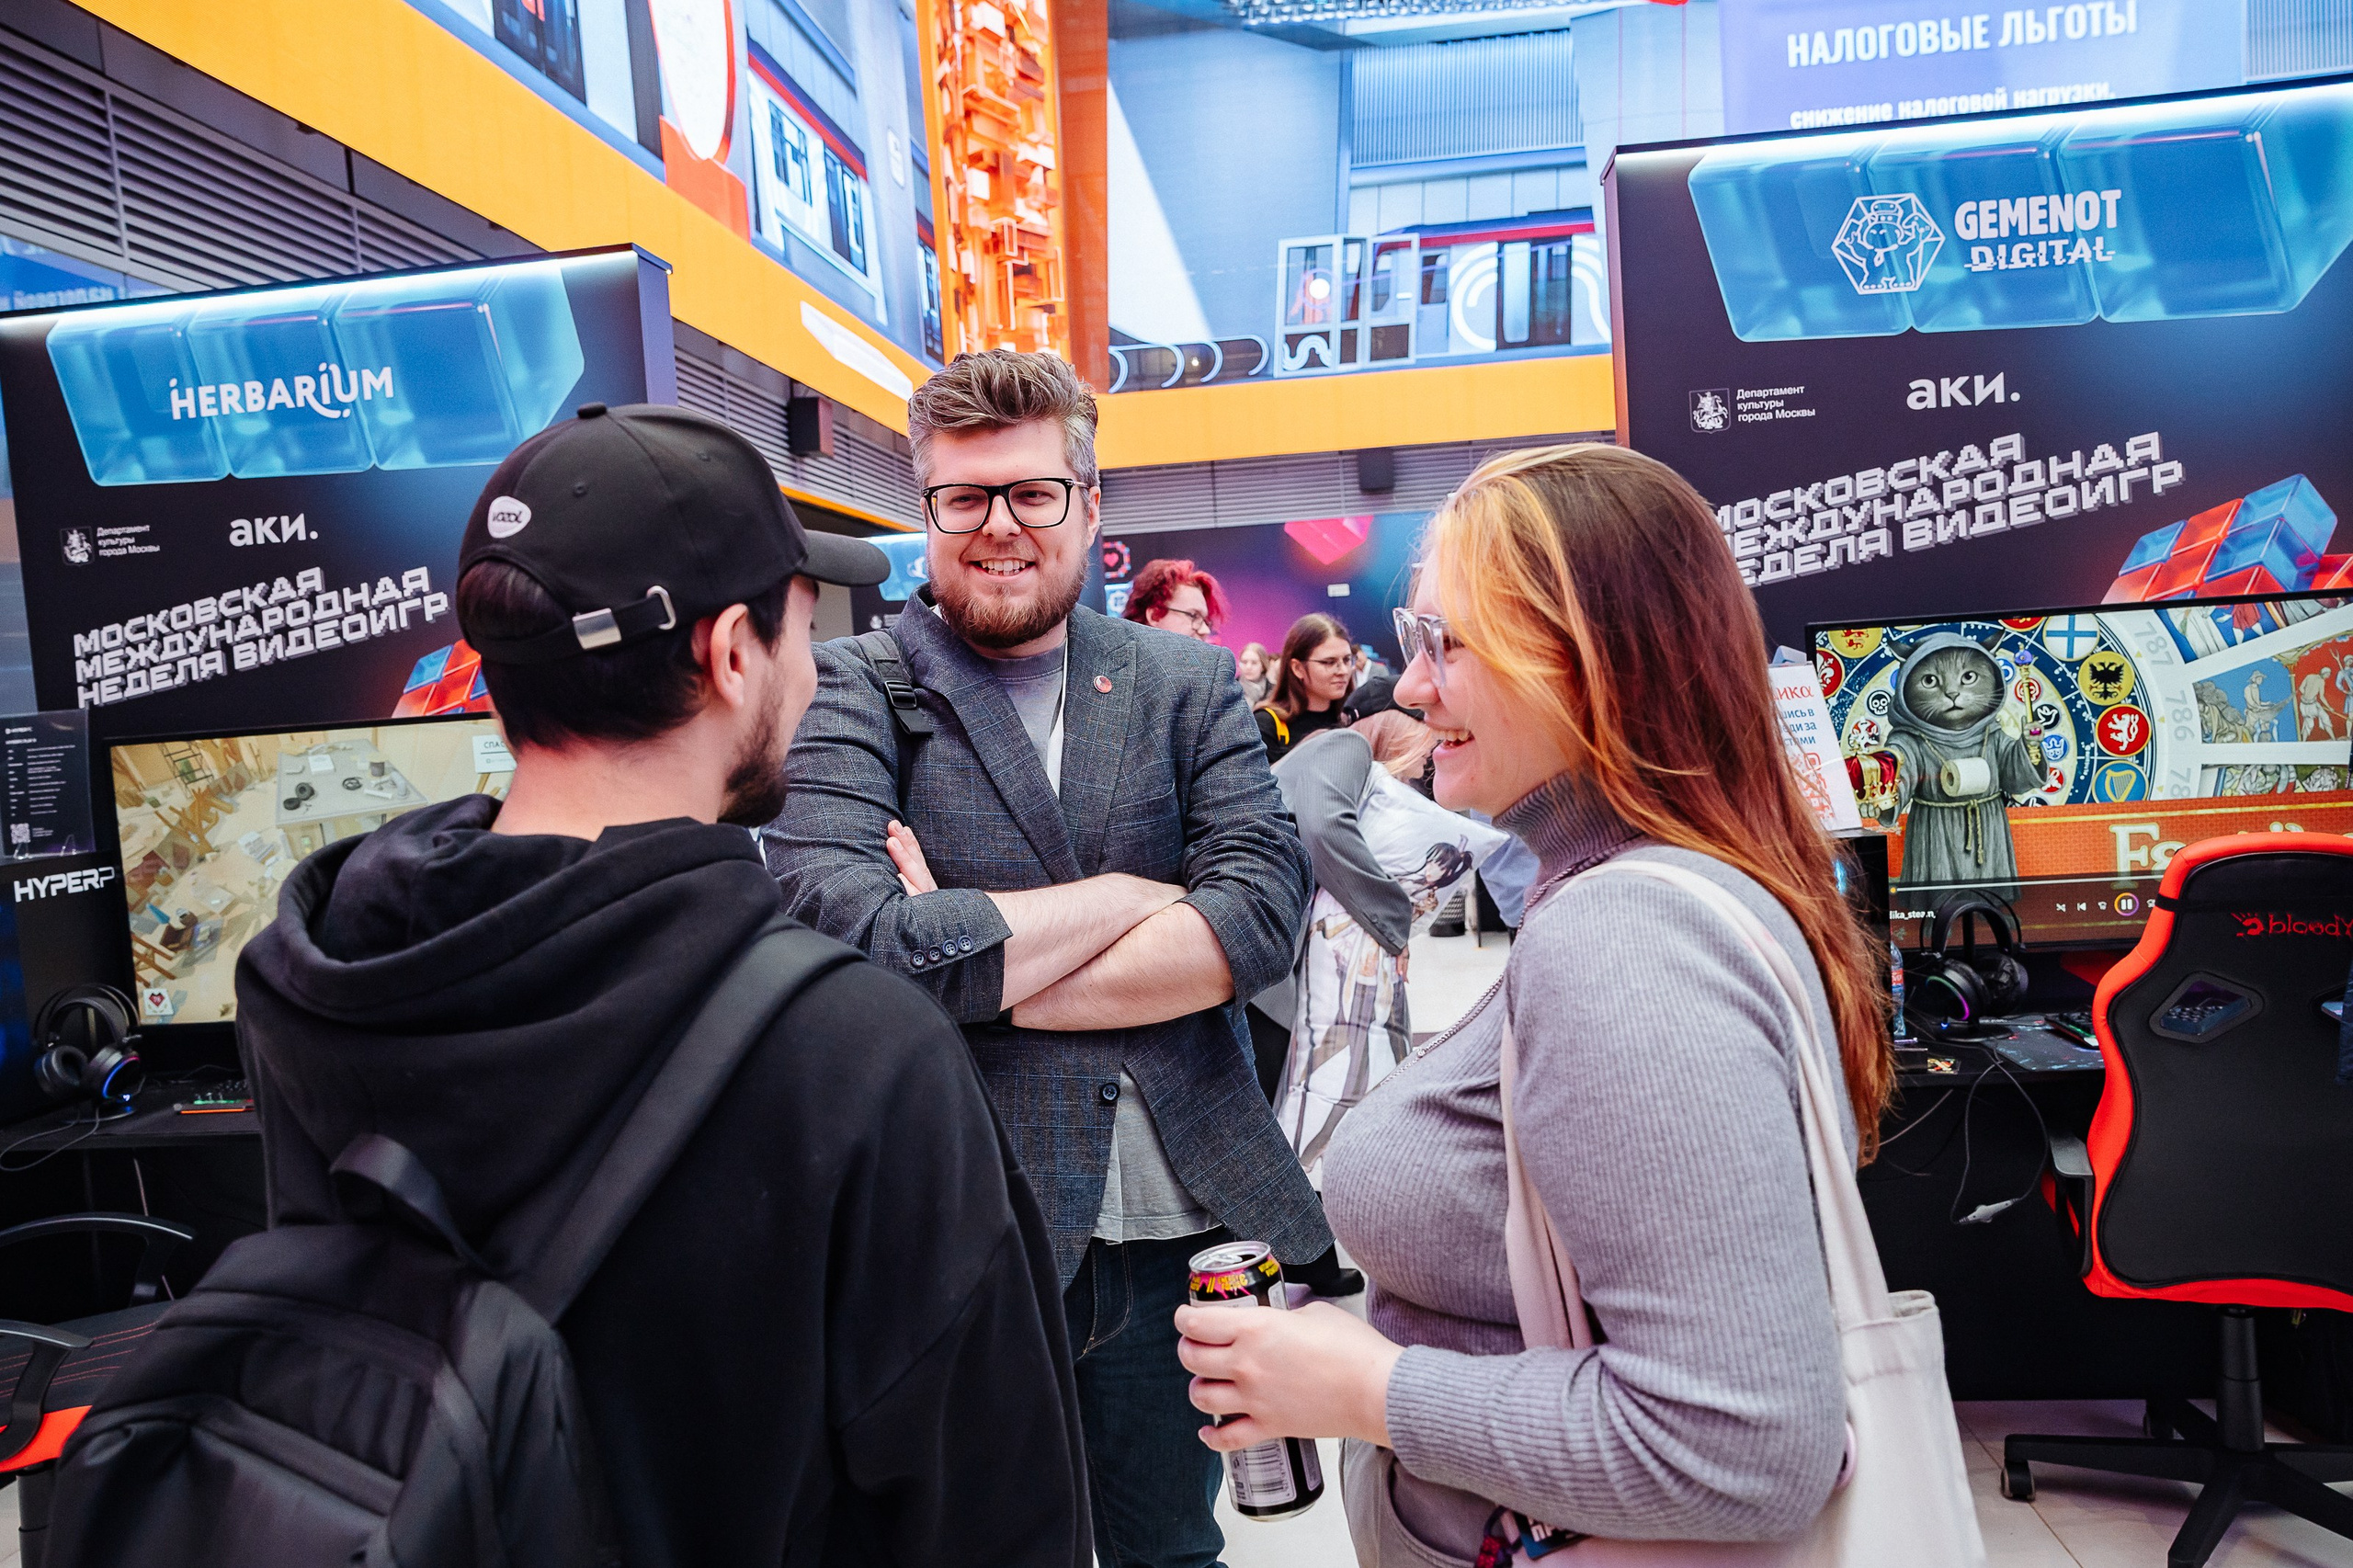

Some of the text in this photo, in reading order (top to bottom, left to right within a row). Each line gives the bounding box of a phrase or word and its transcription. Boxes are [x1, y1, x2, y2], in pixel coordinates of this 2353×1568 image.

[1787, 0, 2138, 68] НАЛОГОВЫЕ ЛЬГОТЫ
[1789, 101, 1893, 130] снижение
[1897, 86, 2008, 120] налоговой
[1954, 189, 2122, 241] GEMENOT
[1964, 236, 2116, 272] DIGITAL
[1736, 385, 1805, 401] Департамент
[1737, 398, 1784, 412] культуры
[1737, 407, 1816, 424] города Москвы
[1724, 430, 2163, 559] ЕЖДУНАРОДНАЯ
[1736, 460, 2187, 588] ЕДЕЛЯ ВИДЕОИГР
[73, 566, 324, 658] МОСКОВСКАЯ
[75, 565, 433, 684] МЕЖДУНАРОДНАЯ
[77, 592, 450, 710] НЕДЕЛЯ ВИДЕОИГР
[2134, 621, 2175, 666] 787
[2165, 690, 2194, 742] 786
